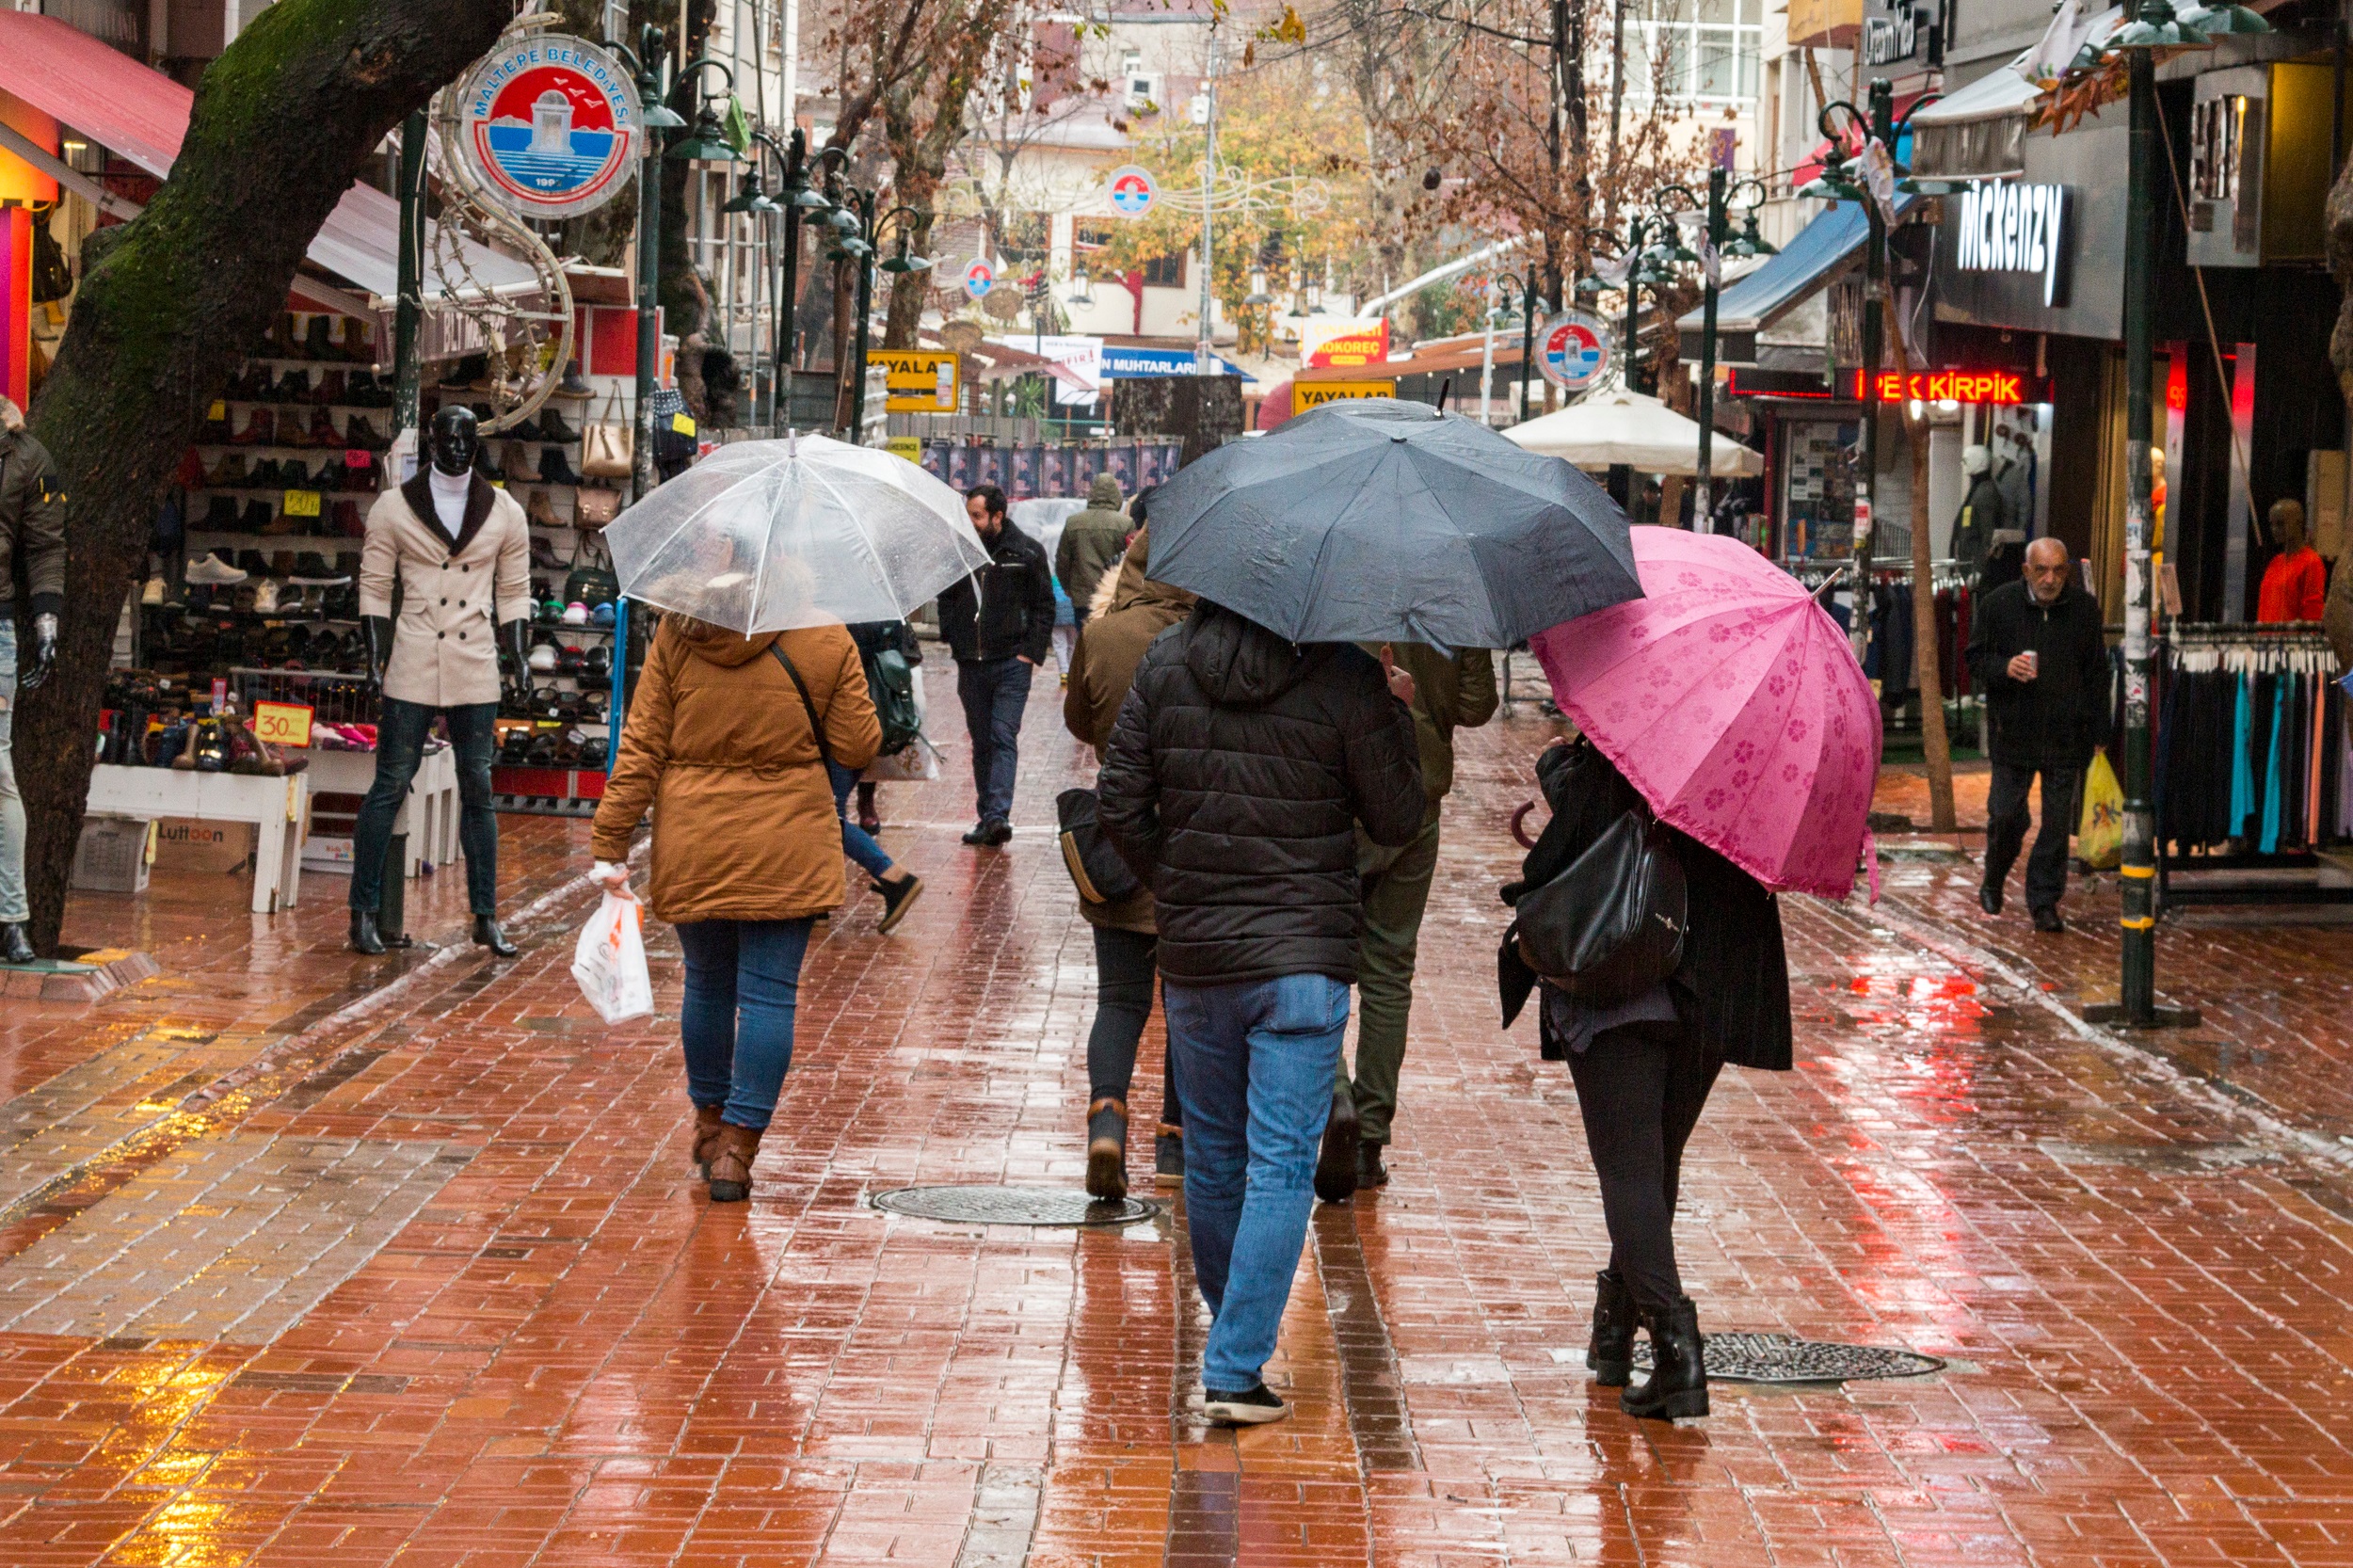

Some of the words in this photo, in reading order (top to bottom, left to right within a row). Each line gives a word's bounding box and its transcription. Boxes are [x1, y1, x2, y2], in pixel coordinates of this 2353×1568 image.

[473, 49, 540, 117] MALTEPE
[1317, 341, 1381, 357] KOKOREÇ
[866, 360, 952, 374] YALA
[1112, 359, 1196, 375] MUHTARLARI
[1856, 369, 1923, 399] İEK
[1929, 371, 2020, 401] KİRPİK
[260, 714, 290, 737] 30
